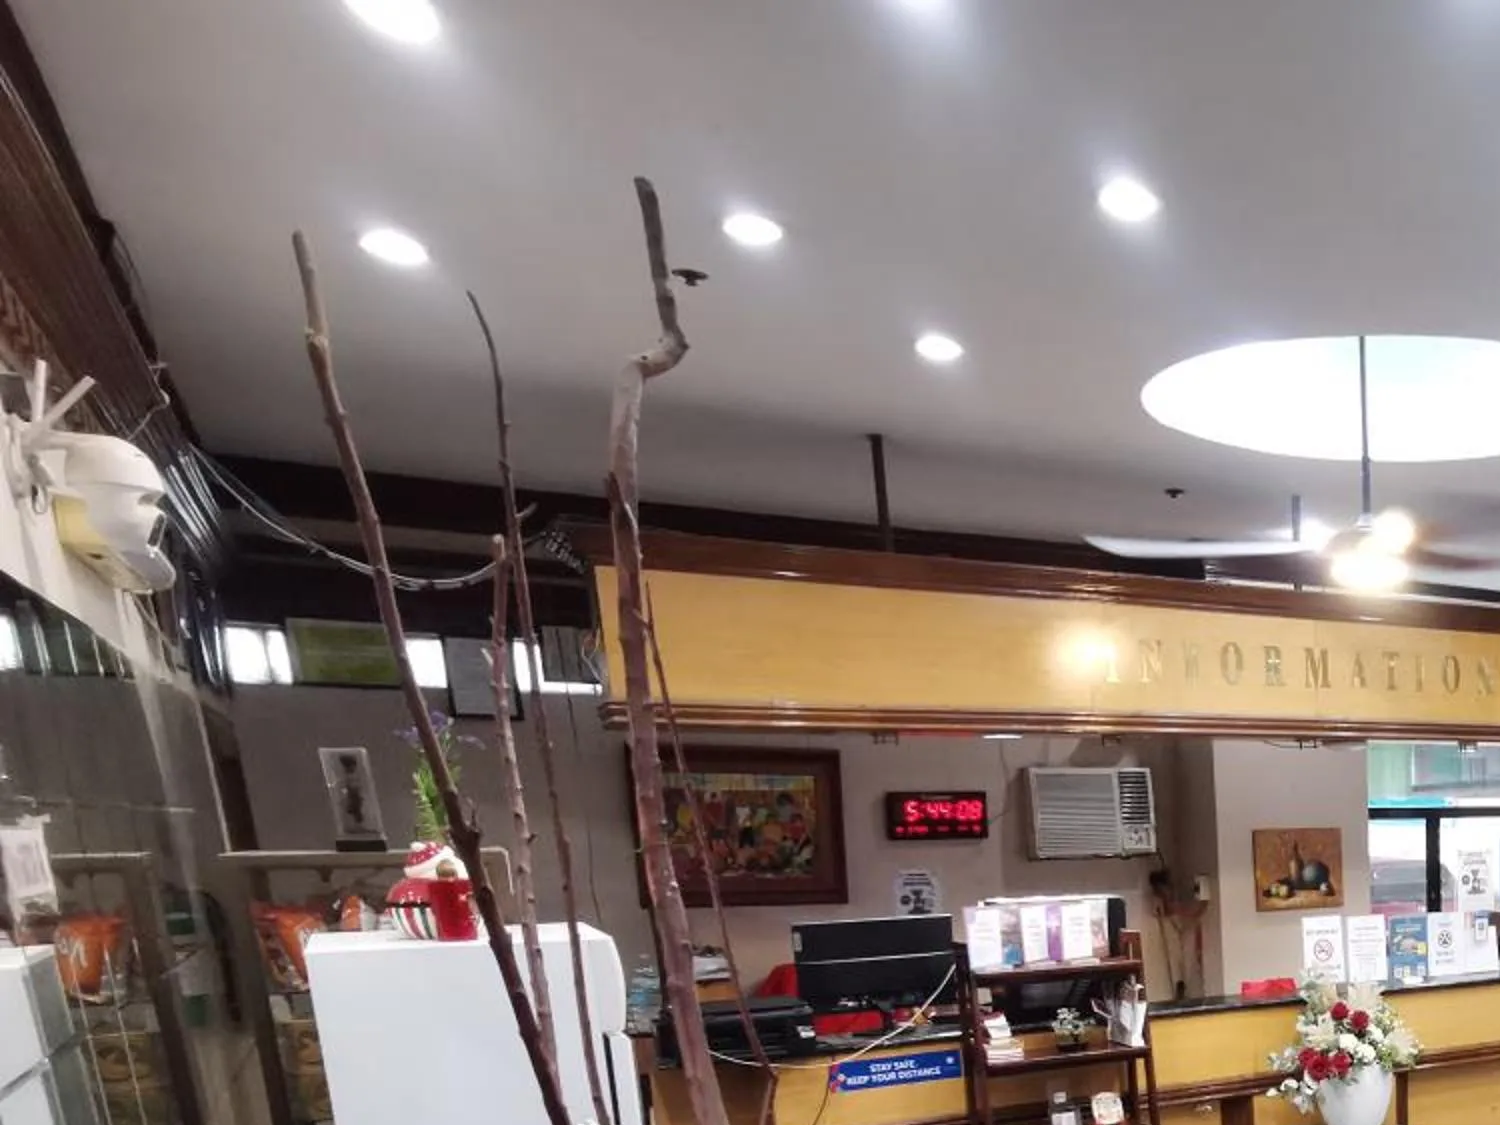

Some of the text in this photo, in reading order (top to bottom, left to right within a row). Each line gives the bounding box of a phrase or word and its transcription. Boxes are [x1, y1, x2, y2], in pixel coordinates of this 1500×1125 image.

[1103, 637, 1498, 696] INFORMATION
[846, 1065, 942, 1085] KEEP YOUR DISTANCE
[869, 1062, 892, 1073] STAY
